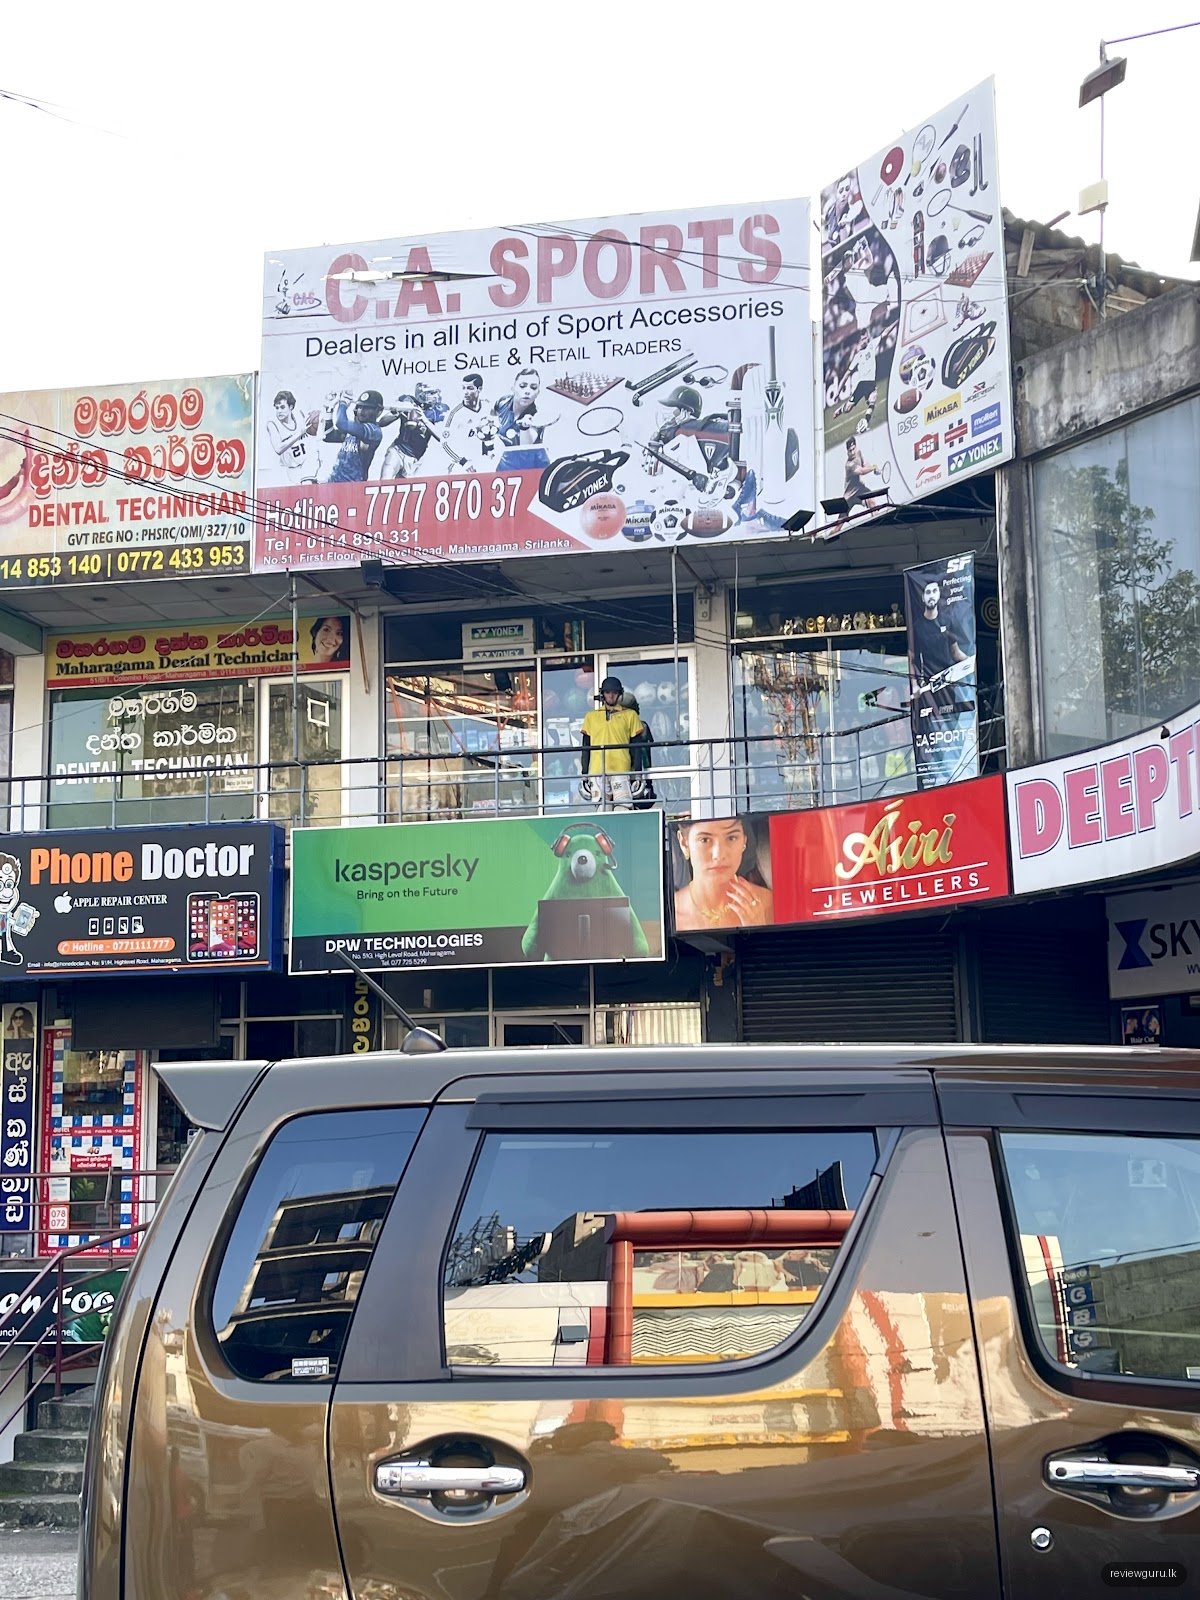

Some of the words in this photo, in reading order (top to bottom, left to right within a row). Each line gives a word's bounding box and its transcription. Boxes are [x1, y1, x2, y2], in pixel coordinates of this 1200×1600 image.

[325, 246, 461, 323] C.A.
[488, 213, 782, 308] SPORTS
[305, 334, 396, 358] Dealers
[405, 329, 424, 350] in
[433, 325, 459, 346] all
[468, 319, 517, 343] kind
[526, 315, 550, 338] of
[557, 310, 623, 338] Sport
[630, 298, 784, 329] Accessories
[507, 348, 521, 366] &
[73, 387, 205, 437] මහරගම
[968, 436, 999, 462] YONEX
[29, 441, 109, 499] දන්ත
[123, 433, 246, 485] කාර්මික
[581, 474, 609, 499] YONEX
[28, 500, 109, 528] DENTAL
[116, 490, 247, 521] TECHNICIAN
[264, 497, 339, 532] Hotline
[365, 482, 427, 527] 7777
[434, 478, 482, 524] 870
[490, 476, 523, 519] 37
[68, 533, 90, 546] GVT
[92, 531, 113, 544] REG
[116, 529, 133, 543] NO
[265, 537, 290, 551] Tel
[306, 532, 347, 549] 0114
[352, 531, 384, 546] 890
[389, 529, 419, 544] 331
[27, 556, 62, 578] 853
[68, 554, 101, 576] 140
[117, 550, 164, 573] 0772
[169, 546, 204, 569] 433
[209, 545, 245, 567] 953
[299, 552, 324, 564] First
[946, 555, 972, 573] SF
[942, 575, 972, 587] Perfecting
[949, 585, 964, 596] your
[491, 625, 519, 637] YONEX
[56, 660, 155, 676] Maharagama
[159, 653, 210, 669] Dental
[214, 648, 299, 666] Technician
[920, 706, 933, 718] SF
[86, 727, 142, 755] දන්ත
[153, 722, 237, 748] කාර්මික
[131, 753, 249, 782] TECHNICIAN
[1014, 720, 1200, 860] DEEPT
[30, 848, 134, 886] Phone
[141, 842, 255, 881] Doctor
[335, 853, 480, 886] kaspersky
[73, 896, 100, 908] APPLE
[101, 895, 132, 907] REPAIR
[134, 894, 168, 906] CENTER
[357, 889, 384, 901] Bring
[387, 890, 400, 898] on
[402, 887, 420, 898] the
[422, 886, 458, 897] Future
[823, 872, 980, 909] JEWELLERS
[72, 941, 104, 952] Hotline
[325, 938, 360, 954] DPW
[363, 933, 484, 951] TECHNOLOGIES
[375, 952, 387, 960] High
[388, 951, 403, 959] Level
[51, 1209, 66, 1218] 078
[51, 1219, 66, 1228] 072
[46, 1326, 76, 1337] Diner
